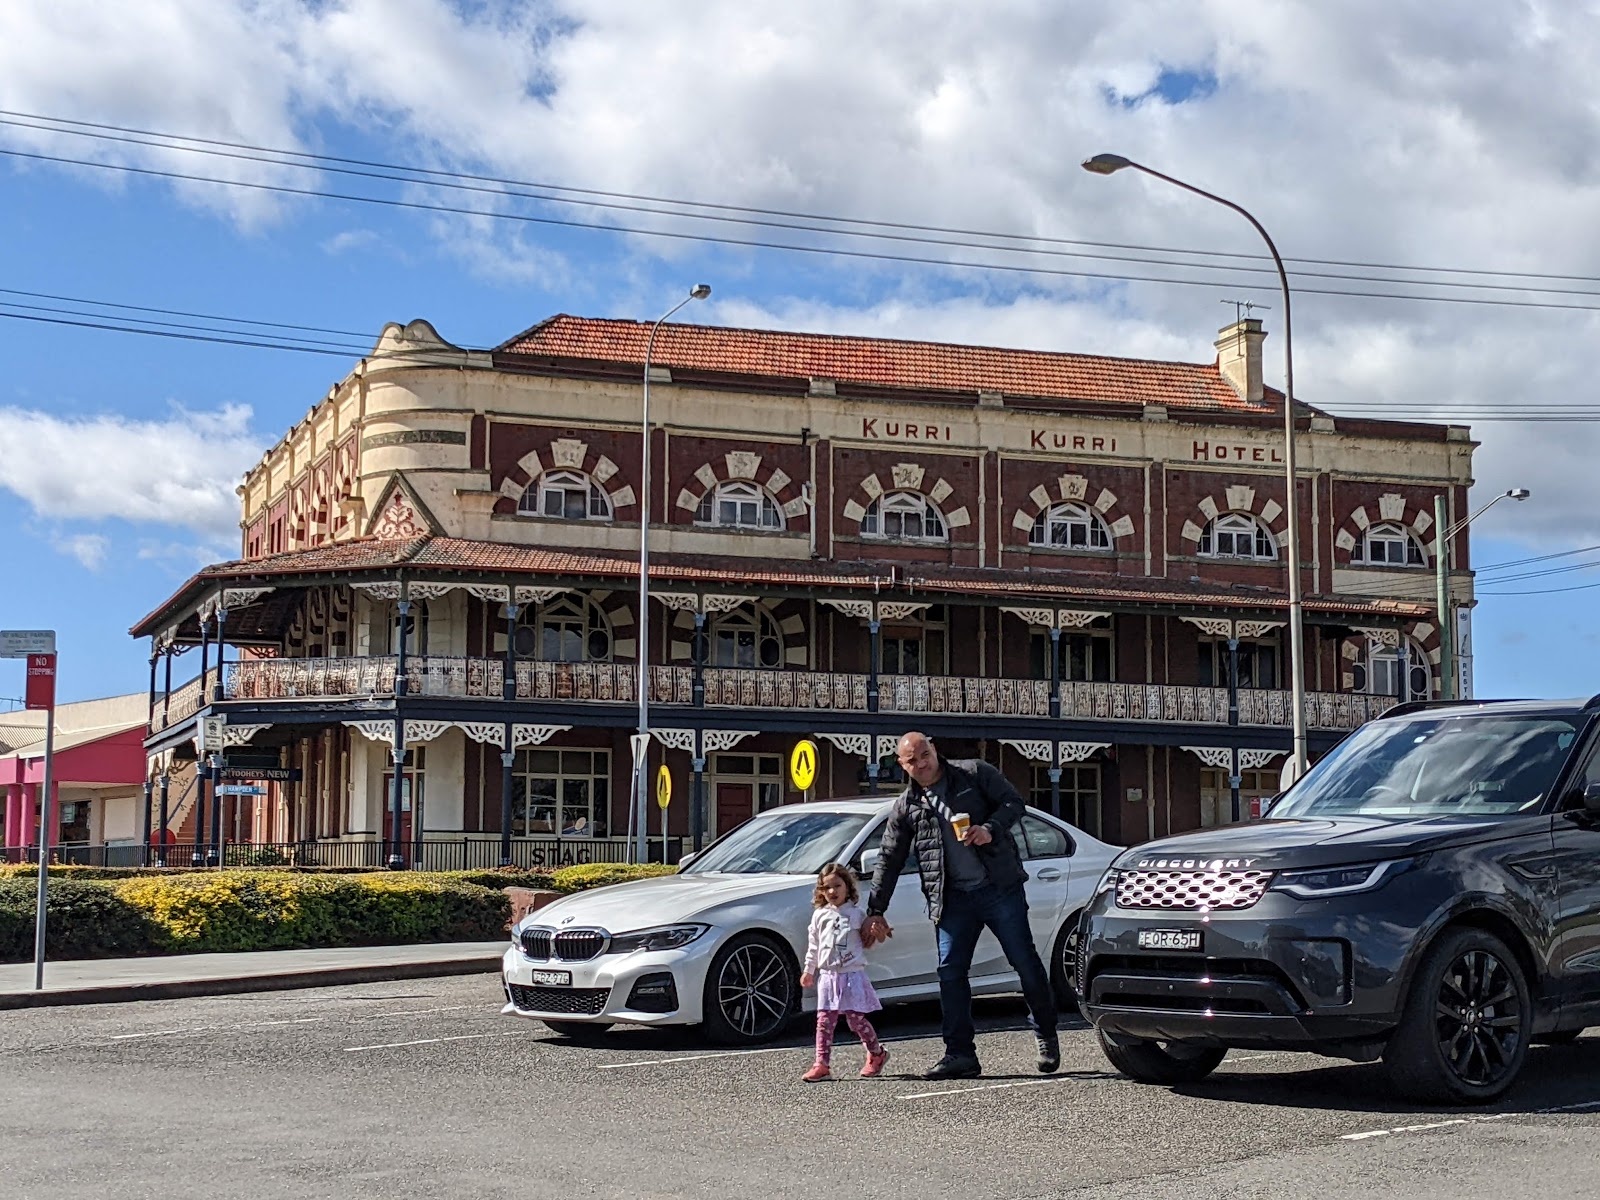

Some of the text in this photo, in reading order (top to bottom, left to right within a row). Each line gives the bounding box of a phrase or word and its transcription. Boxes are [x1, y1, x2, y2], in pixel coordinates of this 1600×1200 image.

[863, 418, 1283, 464] KURRI KURRI HOTEL
[35, 657, 48, 666] NO
[28, 667, 54, 676] STOPPING
[231, 769, 290, 779] TOOHEYS NEW
[531, 847, 590, 866] STAG
